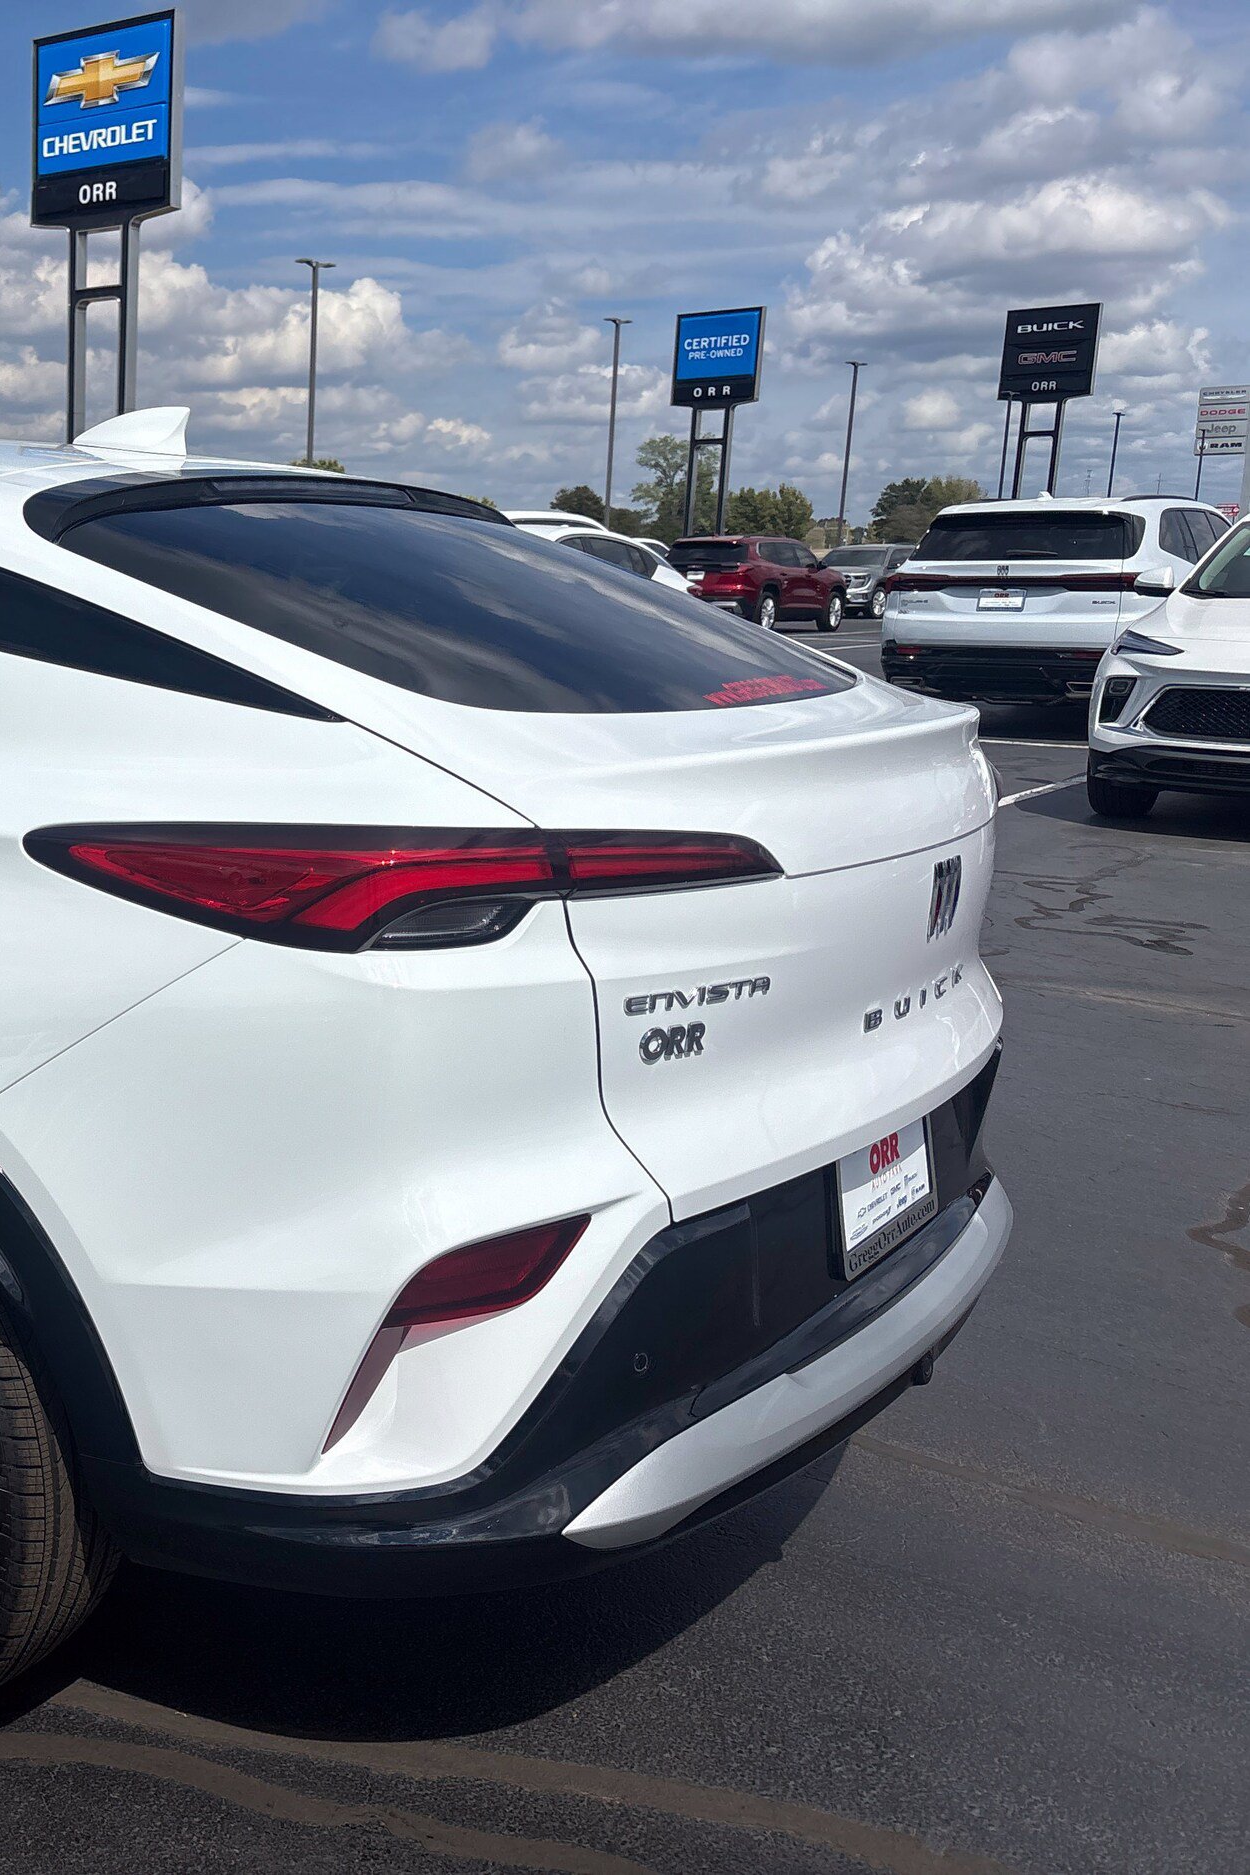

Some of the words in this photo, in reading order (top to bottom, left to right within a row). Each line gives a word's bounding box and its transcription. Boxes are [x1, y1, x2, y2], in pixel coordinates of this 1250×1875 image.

[43, 119, 157, 158] CHEVROLET
[79, 181, 117, 204] ORR
[1017, 320, 1084, 333] BUICK
[684, 334, 750, 350] CERTIFIED
[688, 348, 743, 360] PRE-OWNED
[1018, 350, 1077, 364] GMC
[1031, 381, 1056, 391] ORR
[1206, 424, 1237, 434] Jeep
[623, 976, 771, 1016] ENVISTA
[863, 963, 963, 1034] BUICK
[639, 1021, 706, 1065] ORR
[869, 1132, 901, 1174] ORR
[849, 1199, 935, 1272] GreggOrrAuto.com
